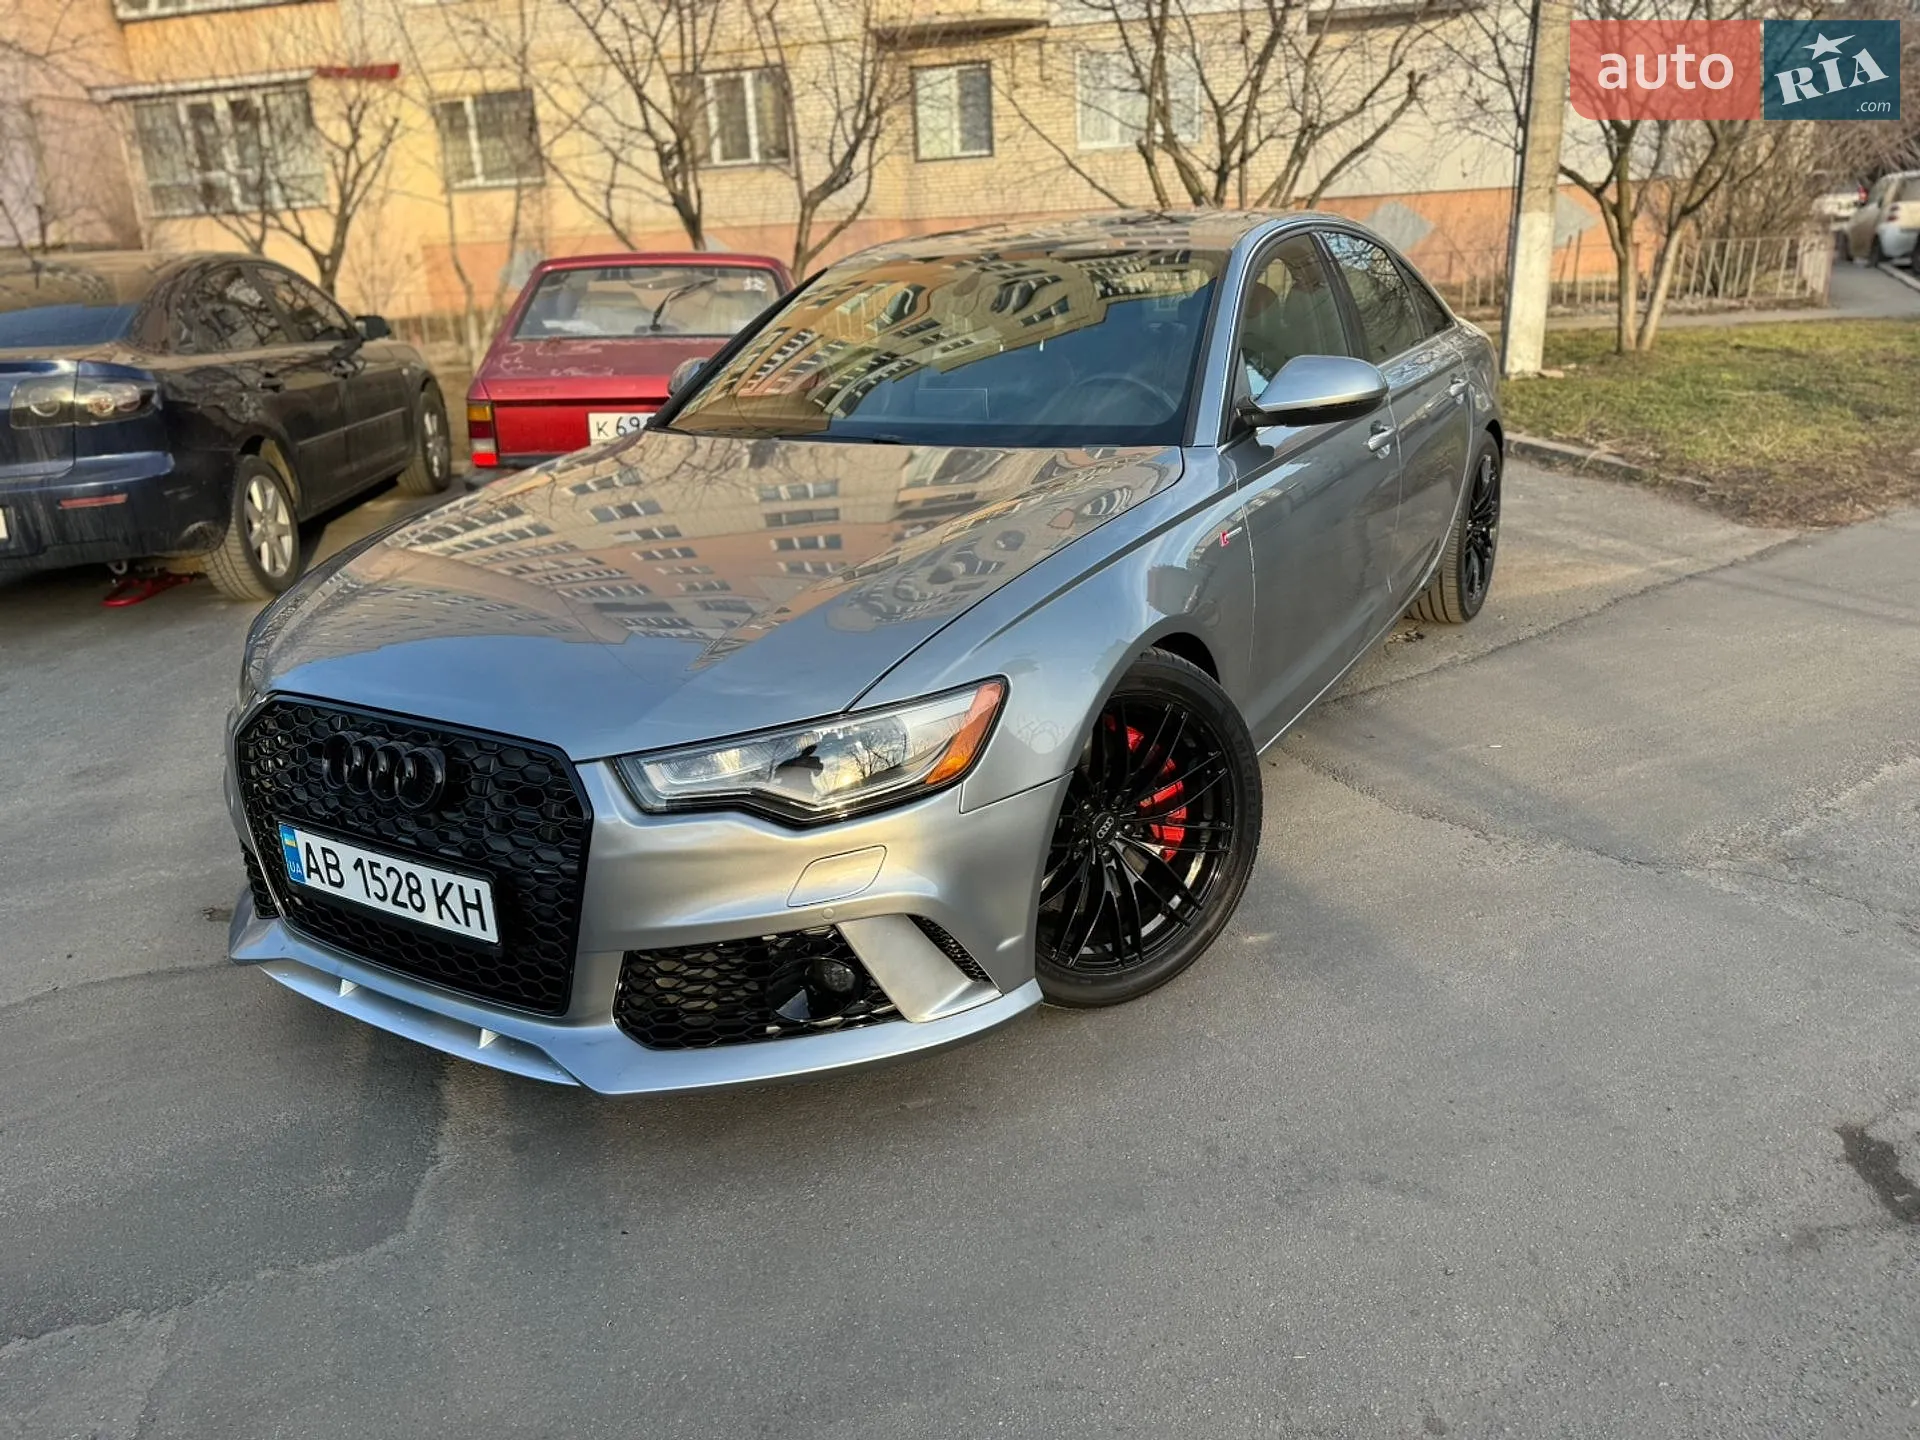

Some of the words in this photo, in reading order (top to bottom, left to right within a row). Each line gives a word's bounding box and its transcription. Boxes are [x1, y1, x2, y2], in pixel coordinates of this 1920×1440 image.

[289, 860, 304, 876] UA
[305, 841, 345, 888] AB
[353, 857, 426, 913] 1528
[432, 878, 487, 932] KH
